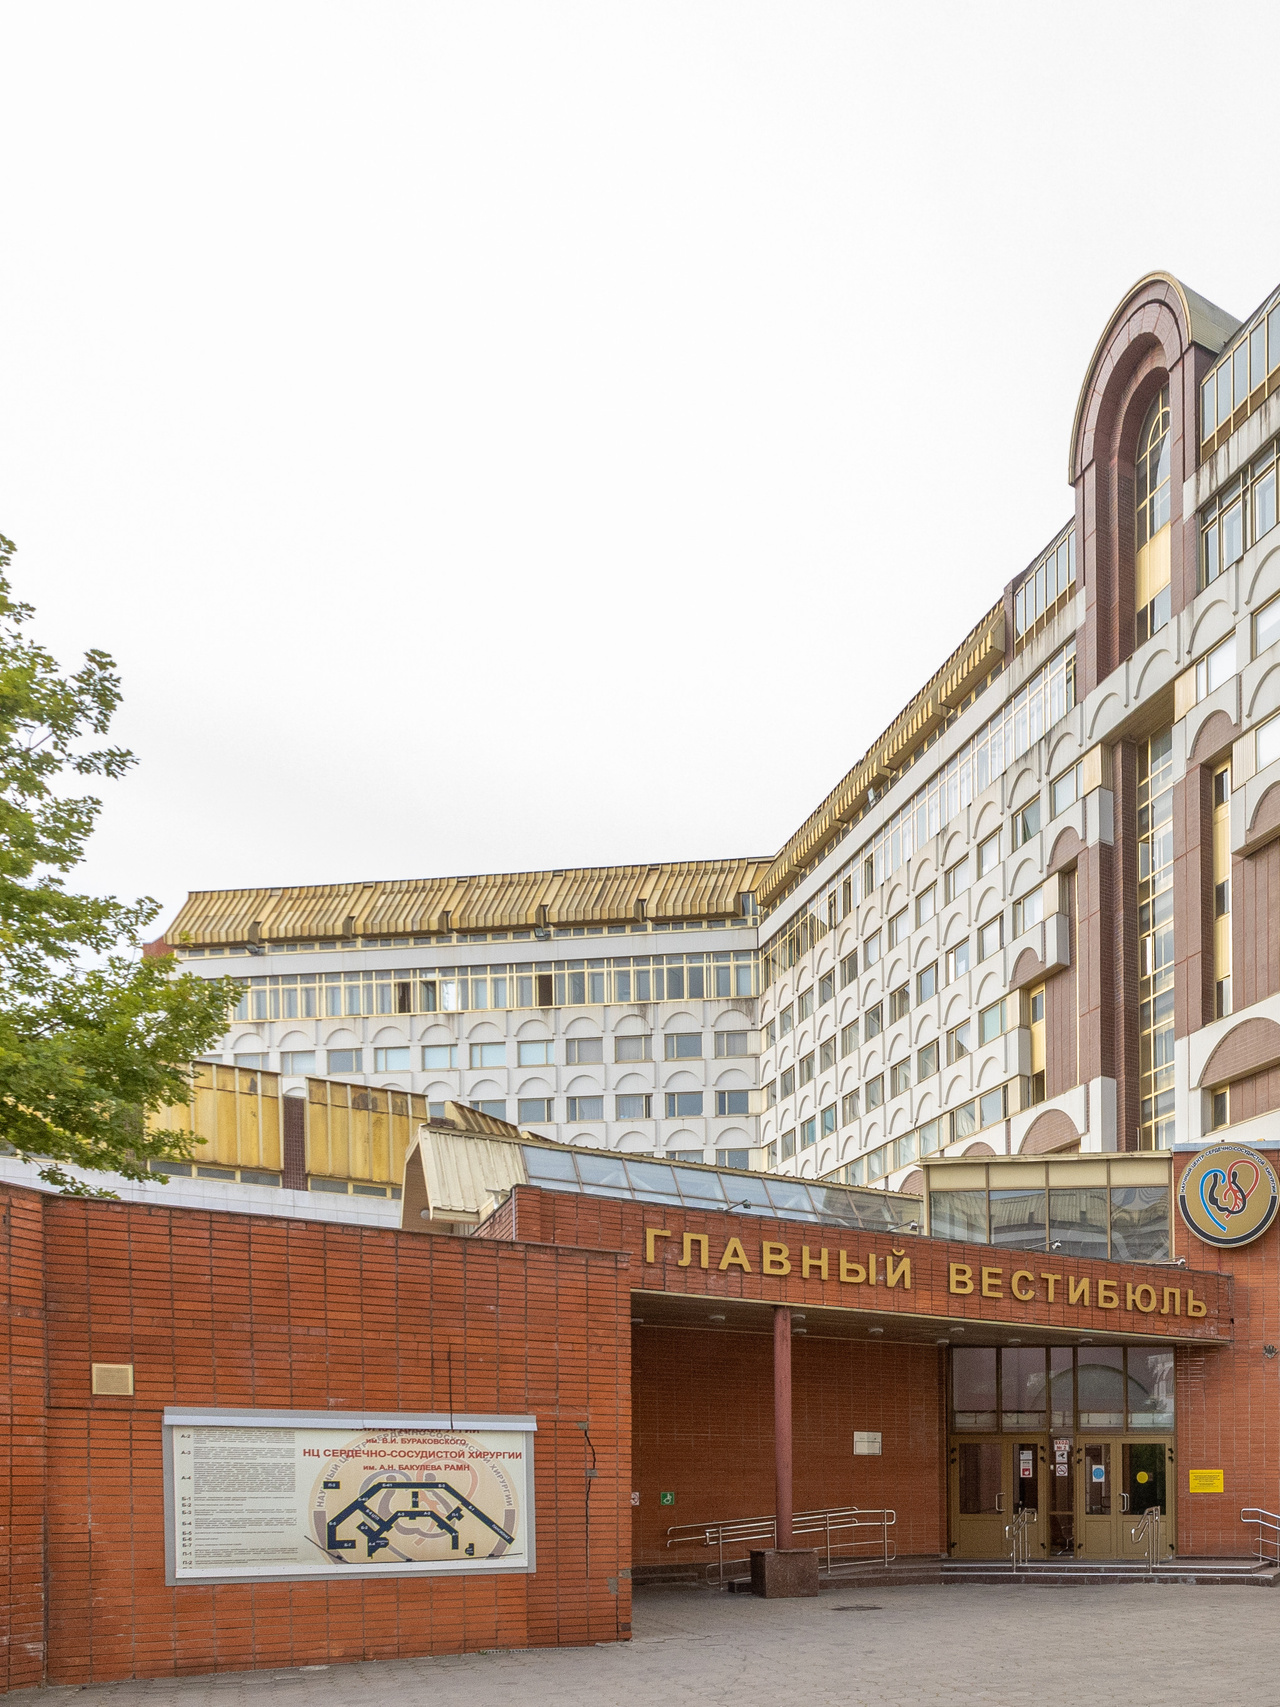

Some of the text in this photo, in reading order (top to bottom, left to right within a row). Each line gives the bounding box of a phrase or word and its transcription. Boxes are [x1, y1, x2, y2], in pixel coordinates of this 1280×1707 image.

[1181, 1146, 1276, 1193] НАУЧНЫЙ ЦЕНТР СЕРДЕЧНО-СОСУДИСТОЙ ХИРУРГИИ
[645, 1227, 1208, 1318] ГЛАВНЫЙ ВЕСТИБЮЛЬ
[303, 1448, 320, 1458] НЦ
[323, 1449, 465, 1459] СЕРДЕЧНО-СОСУДИСТОЙ
[468, 1451, 522, 1459] ХИРУРГИИ
